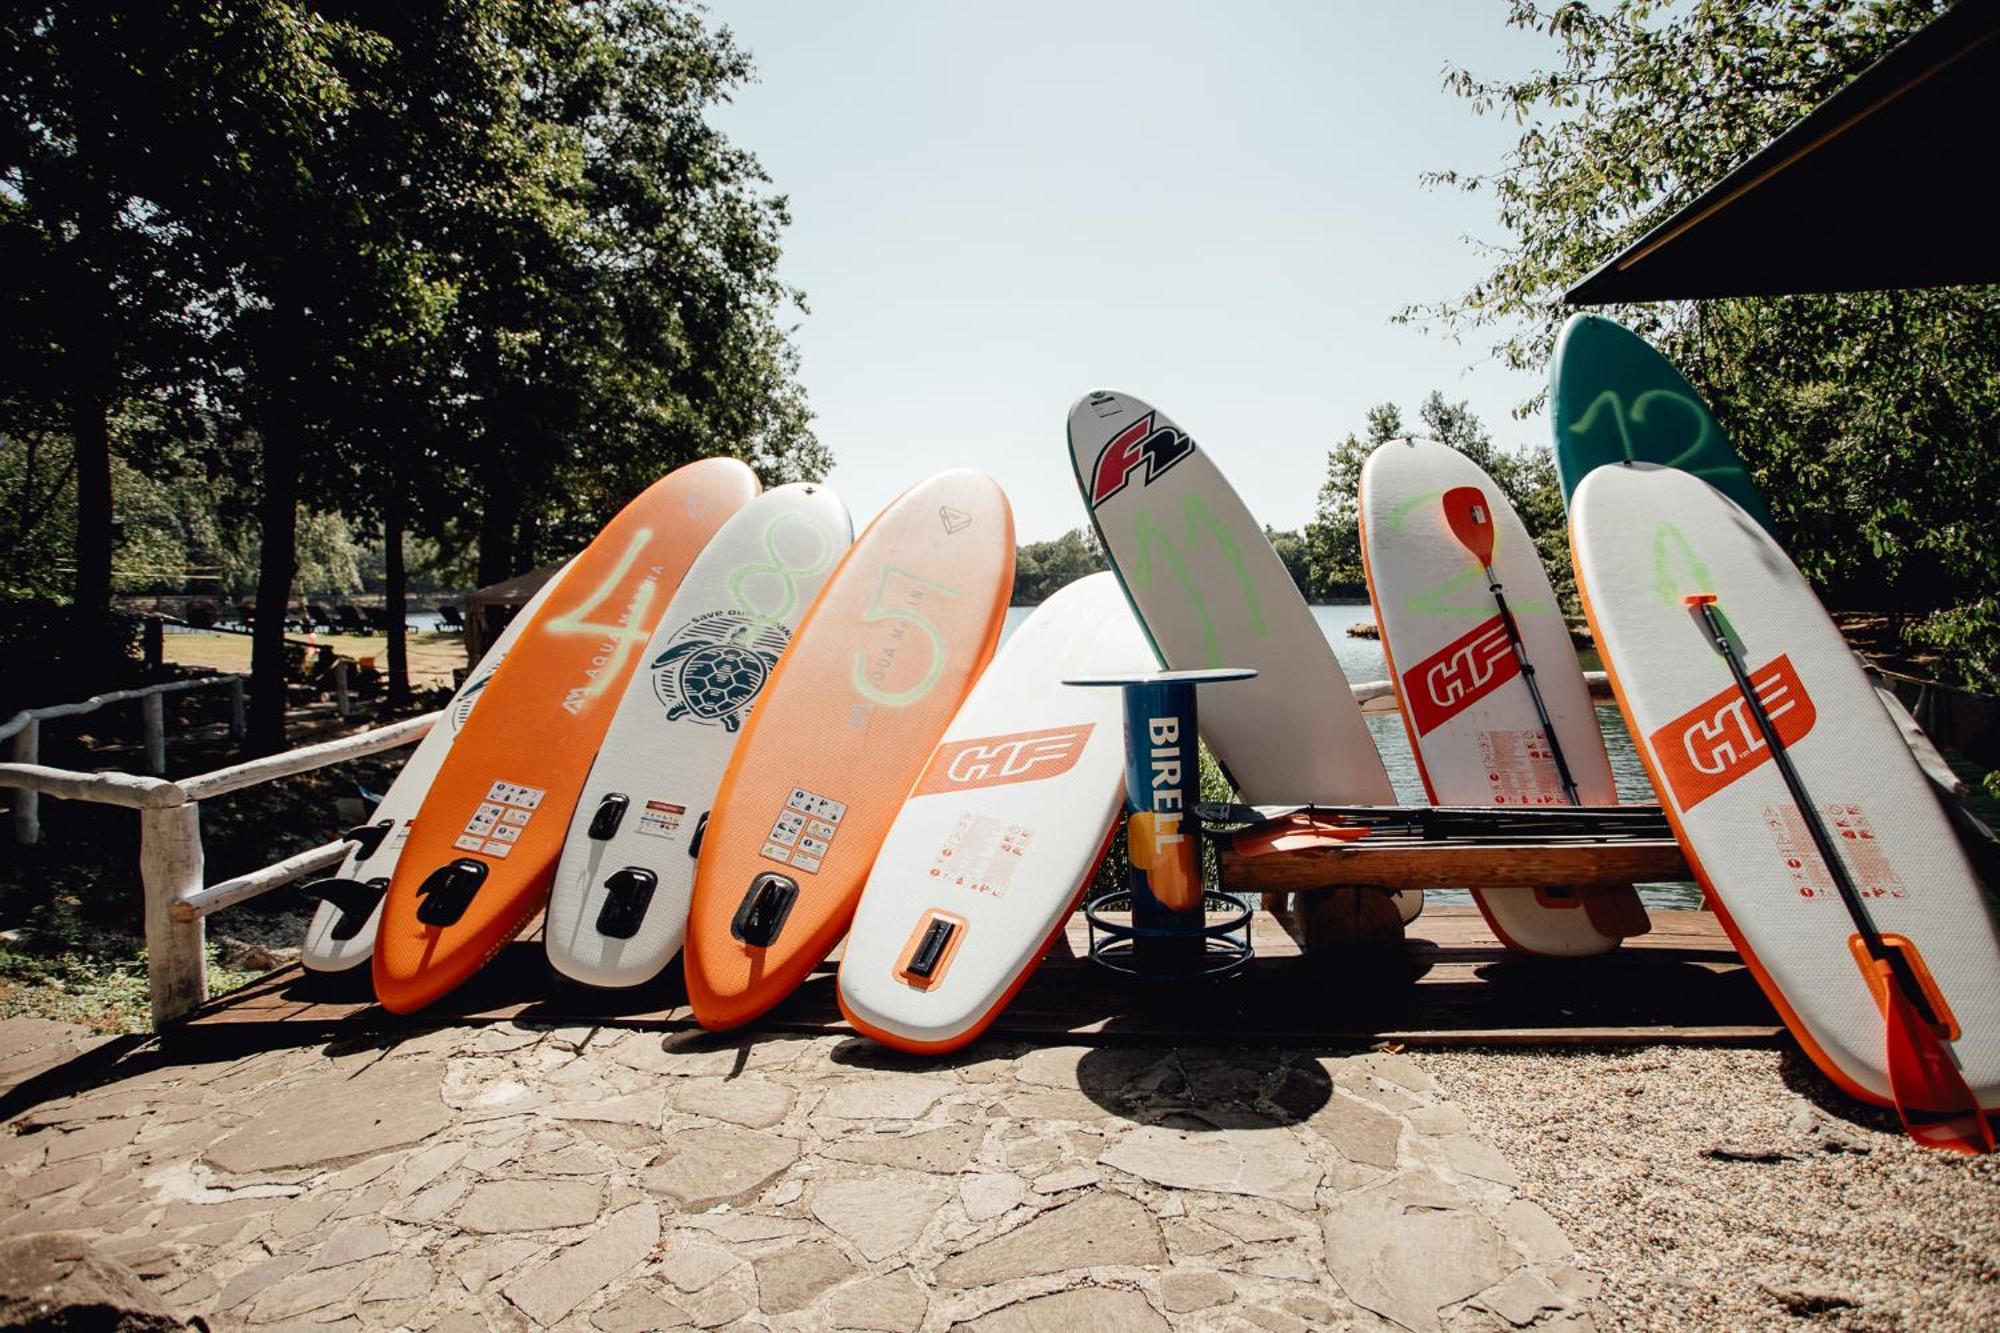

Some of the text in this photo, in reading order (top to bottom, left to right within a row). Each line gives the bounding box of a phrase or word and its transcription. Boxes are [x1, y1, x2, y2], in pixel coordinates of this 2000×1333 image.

[1090, 408, 1195, 511] F2
[1568, 388, 1744, 475] 12
[544, 527, 654, 714] 4
[728, 513, 831, 630] 8
[854, 564, 961, 706] 5
[1148, 716, 1185, 854] BIRELL
